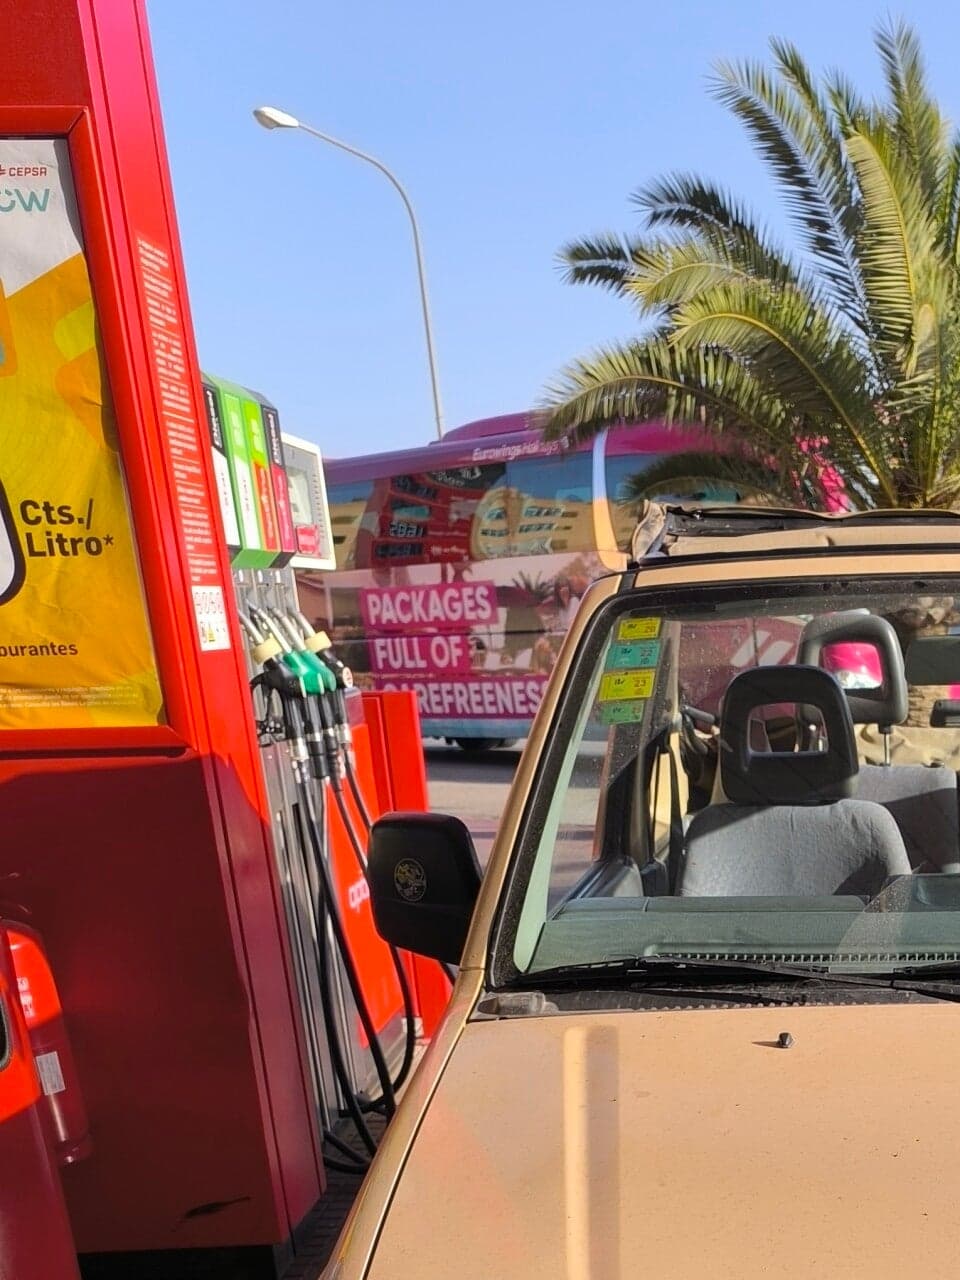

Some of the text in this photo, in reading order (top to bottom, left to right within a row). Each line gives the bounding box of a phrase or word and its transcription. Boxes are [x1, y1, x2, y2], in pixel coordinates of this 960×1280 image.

[8, 166, 48, 177] CEPSA
[20, 498, 94, 531] Cts./
[366, 586, 492, 626] PACKAGES
[374, 634, 464, 670] FULL OF
[382, 679, 549, 715] REFREENES
